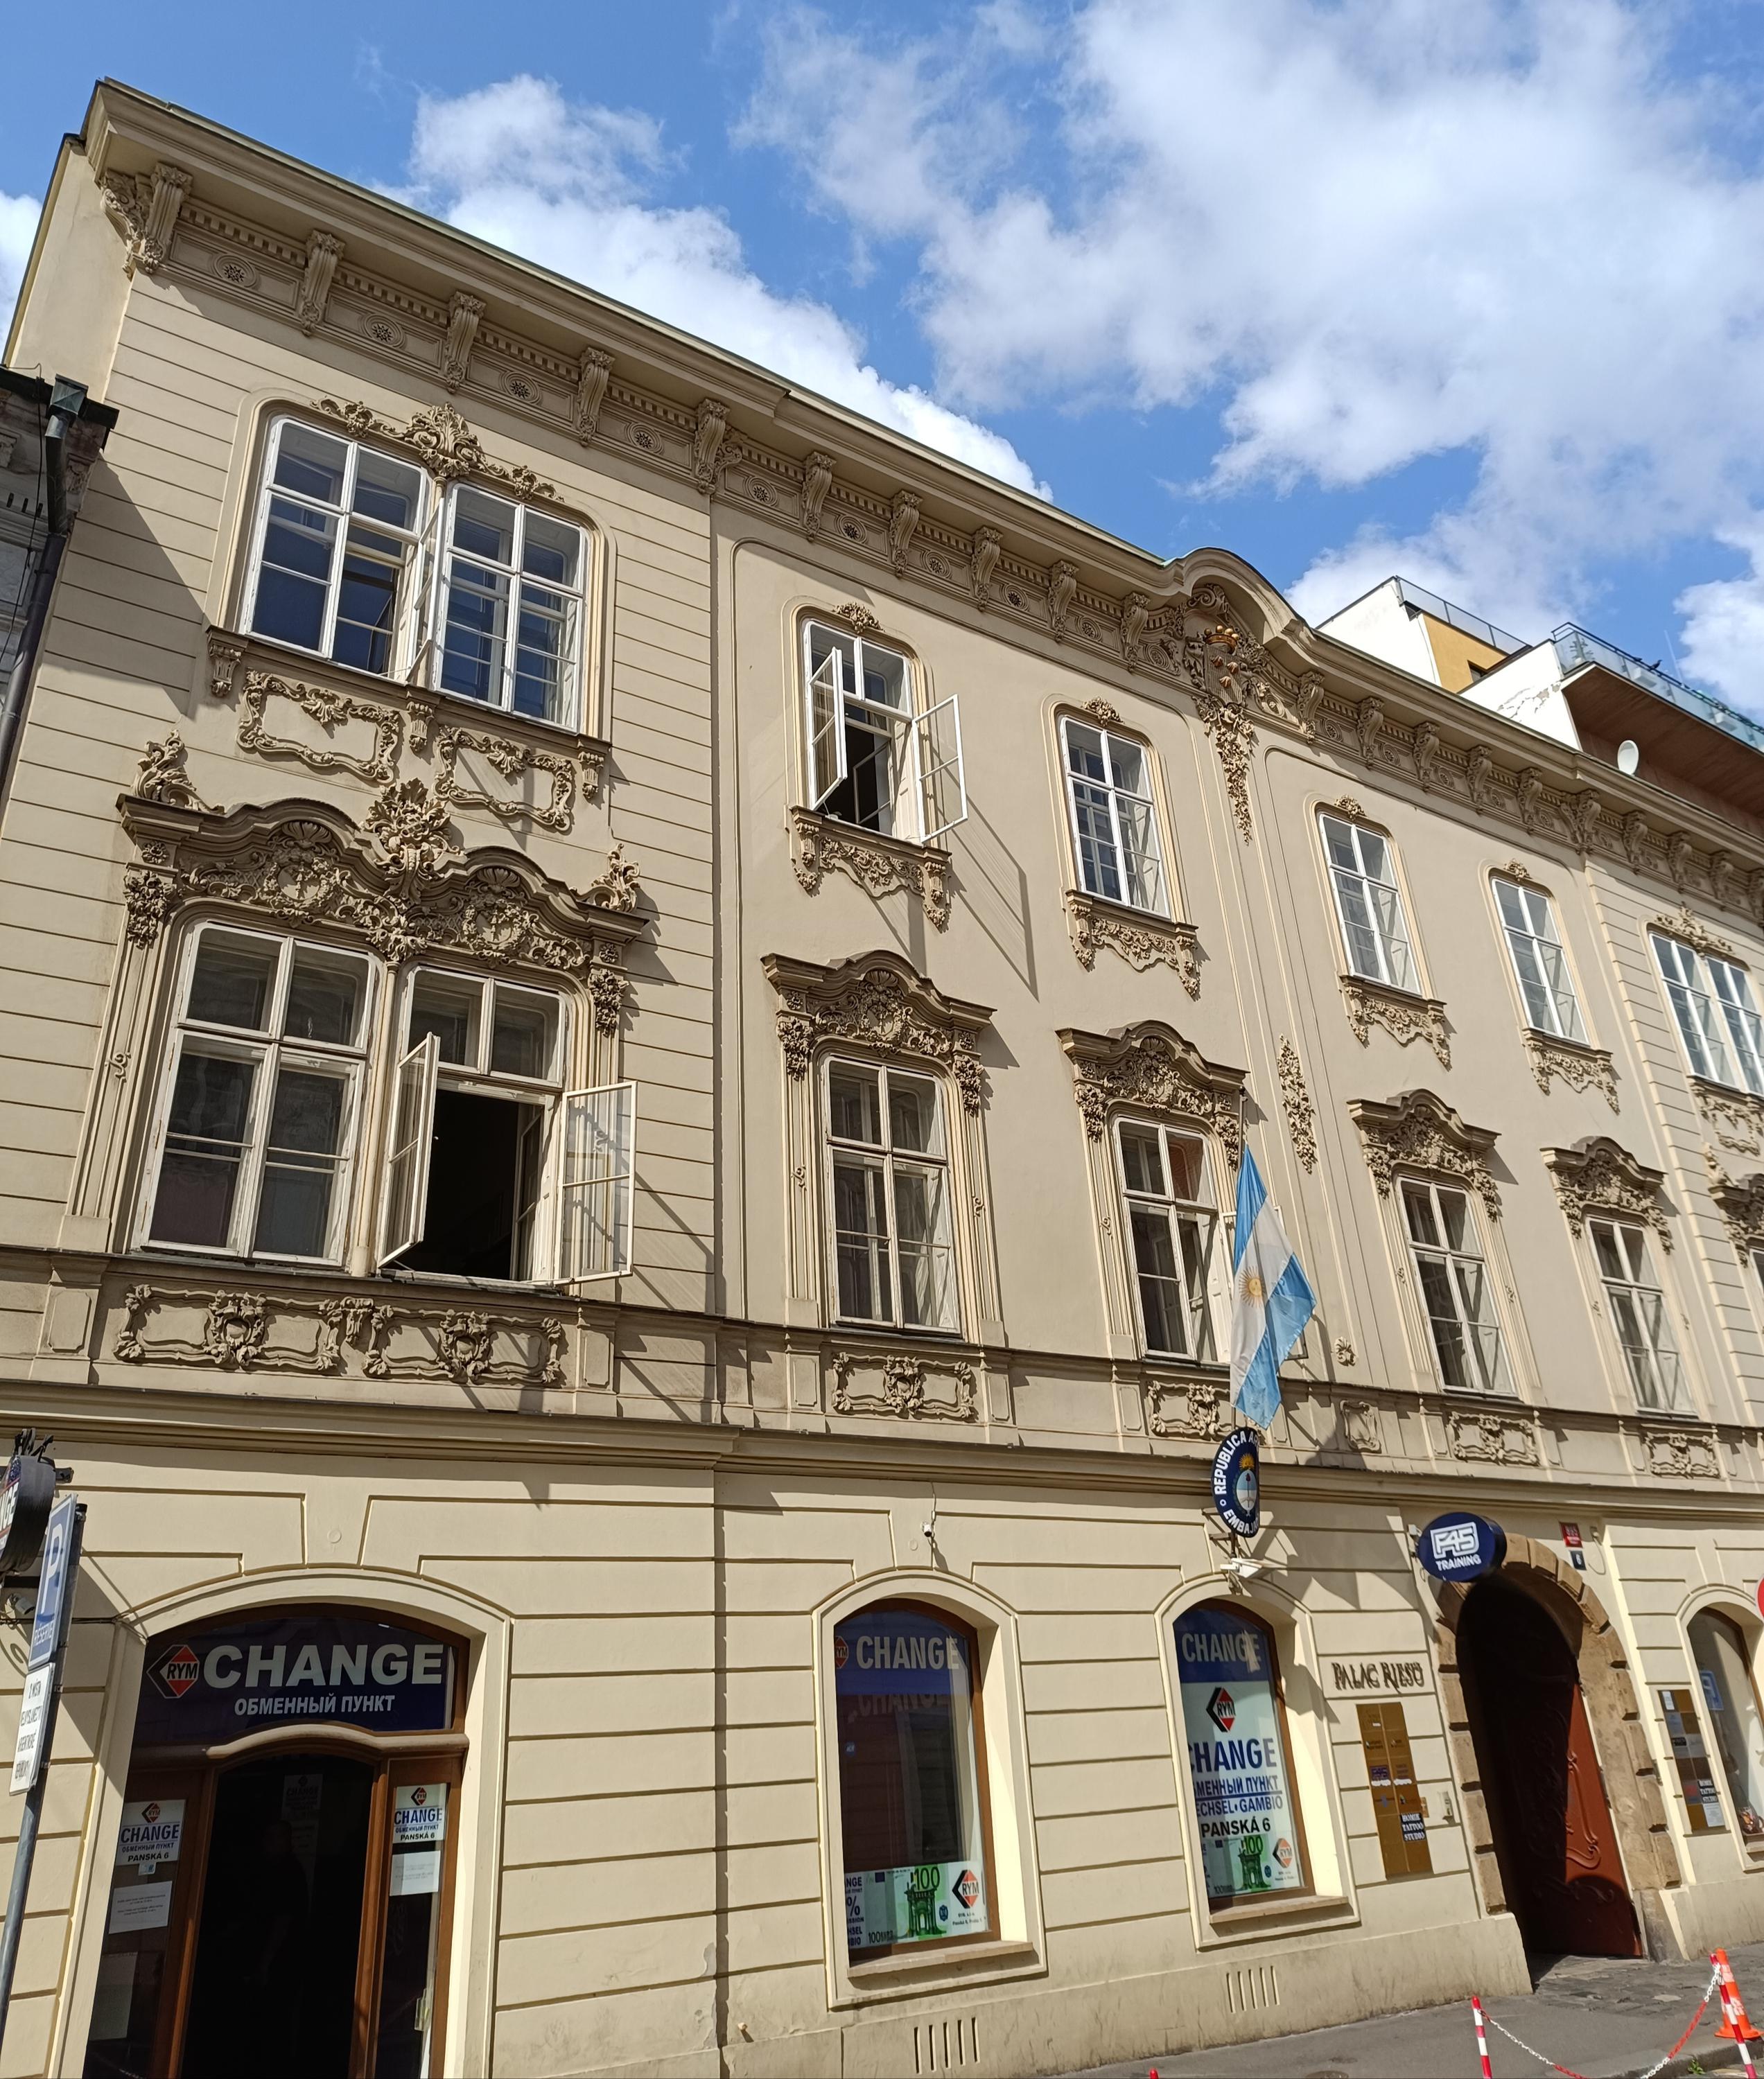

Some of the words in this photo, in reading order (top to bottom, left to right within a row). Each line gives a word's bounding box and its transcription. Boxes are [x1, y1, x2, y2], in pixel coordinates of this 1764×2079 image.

[1214, 1430, 1247, 1495] REPUBLICA
[40, 1523, 63, 1614] P
[1435, 1554, 1482, 1571] TRAINING
[856, 1635, 959, 1669] CHANGE
[1182, 1632, 1261, 1663] CHANGE
[166, 1661, 199, 1681] RYM
[204, 1643, 444, 1689] CHANGE
[234, 1693, 335, 1716] ОБМЕННЫЙ
[341, 1695, 395, 1712] ПУНКТ
[1216, 1701, 1236, 1717] RYM
[1188, 1737, 1277, 1773] HANGE
[1194, 1776, 1244, 1796] МЕННЫЙ
[1246, 1775, 1278, 1793] ПУНКТ
[394, 1807, 443, 1825] CHANGE
[1196, 1798, 1234, 1817] ECHSEL
[121, 1824, 180, 1843] CHANGE
[401, 1832, 428, 1841] PANSKÁ
[1200, 1816, 1260, 1838] PANSKÁ
[1262, 1818, 1270, 1832] 6
[128, 1851, 161, 1862] PANSKÁ
[846, 1877, 862, 1887] NGE
[914, 1866, 940, 1891] 100
[962, 1881, 979, 1895] RYM
[850, 1936, 862, 1946] BIO
